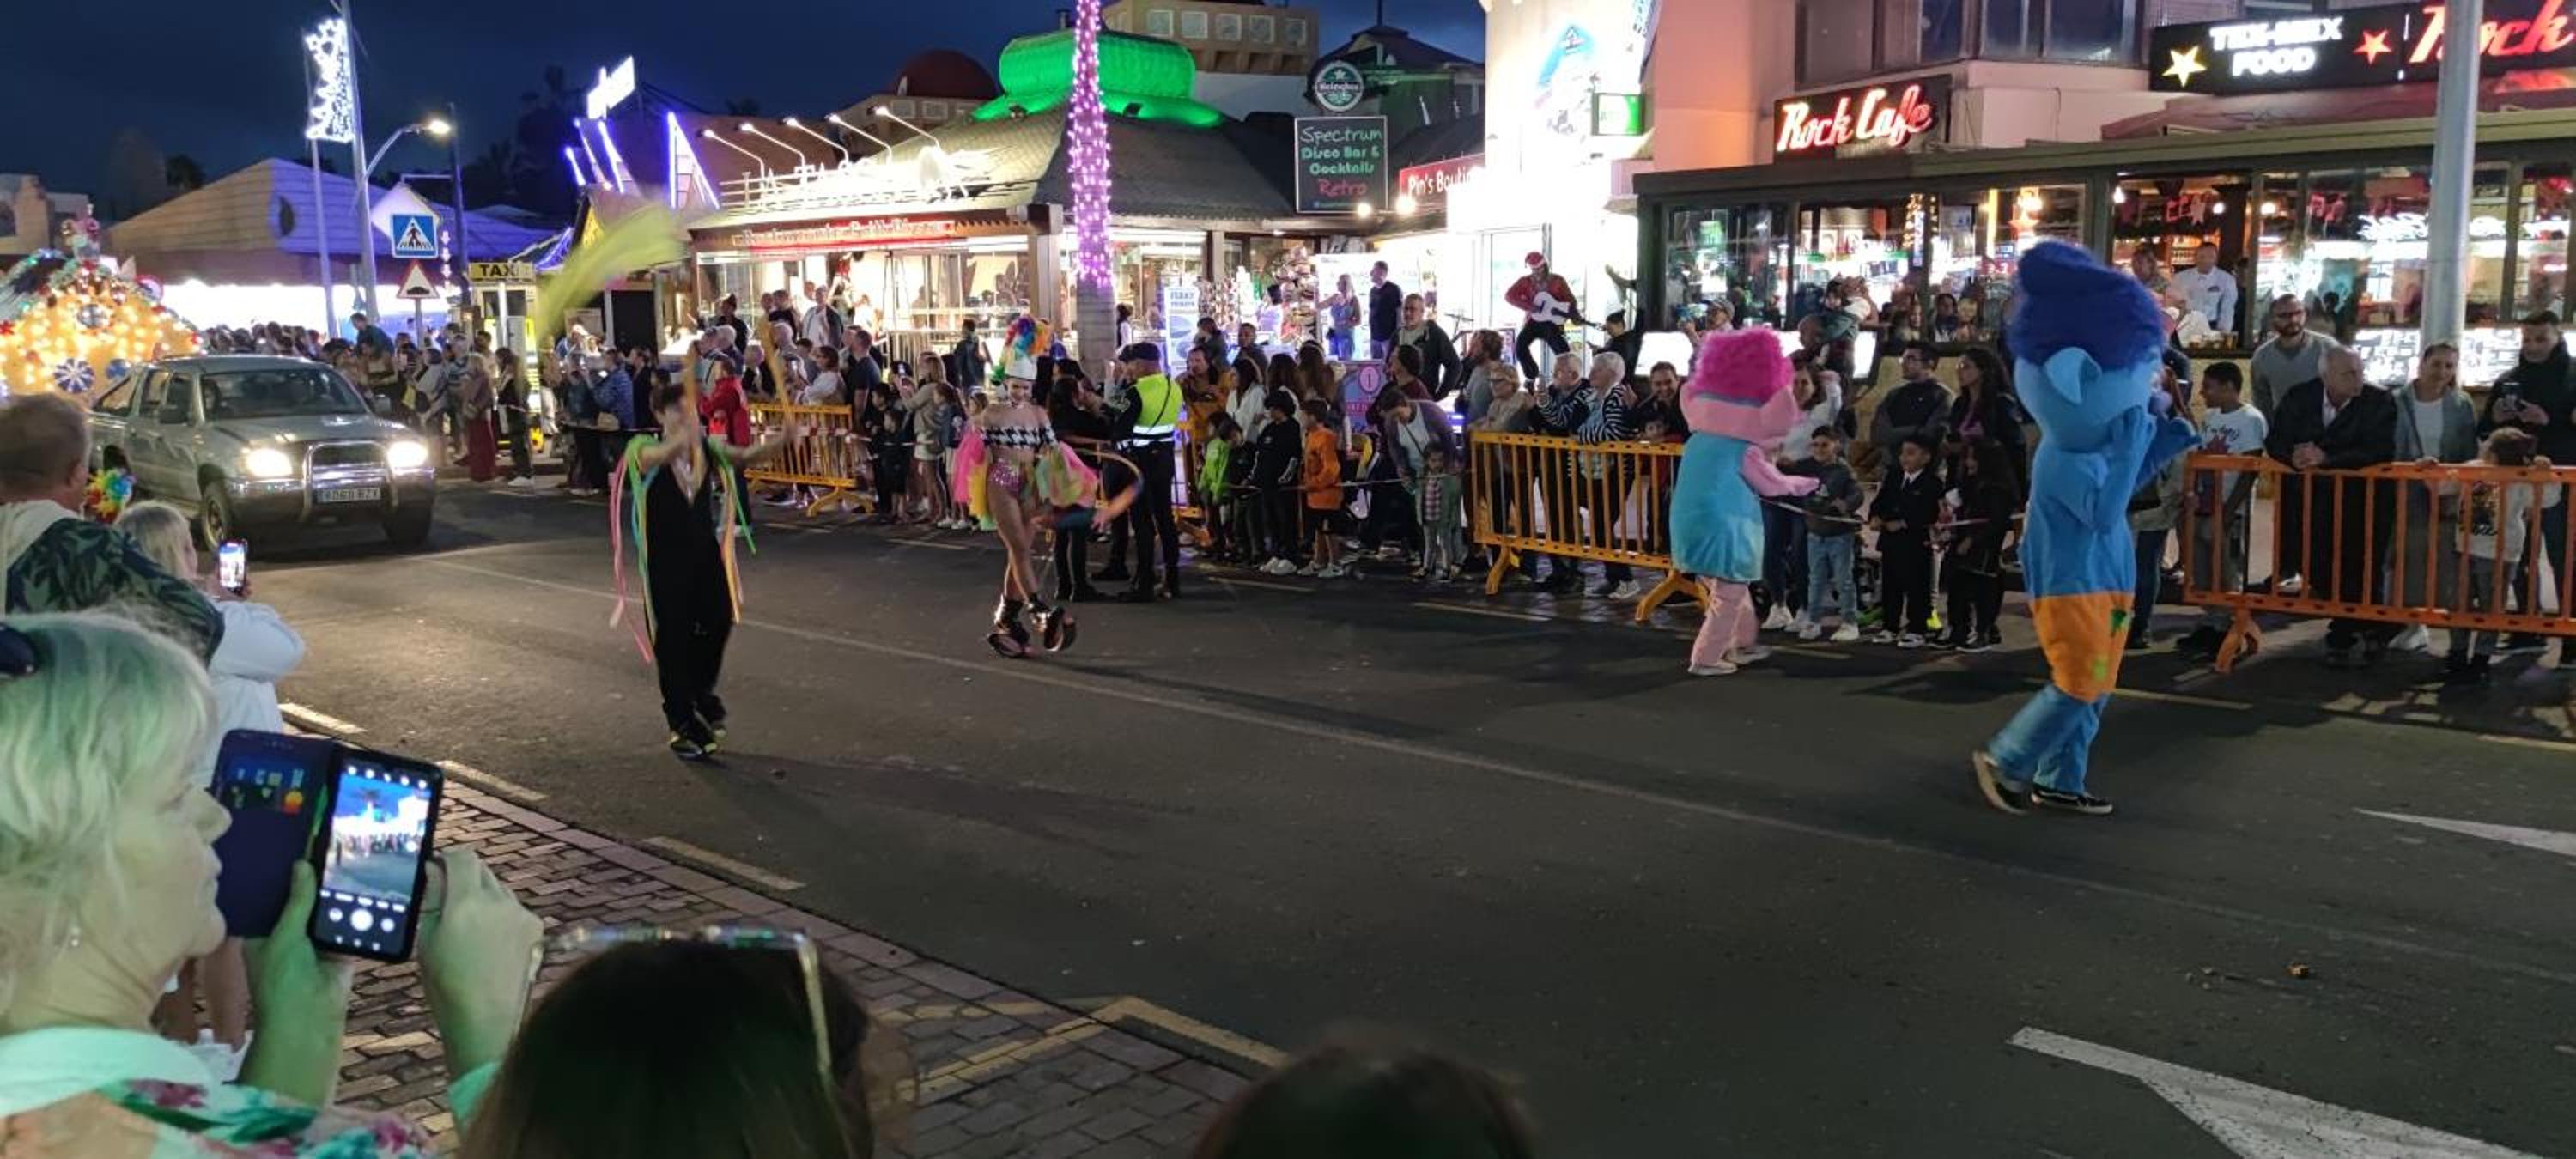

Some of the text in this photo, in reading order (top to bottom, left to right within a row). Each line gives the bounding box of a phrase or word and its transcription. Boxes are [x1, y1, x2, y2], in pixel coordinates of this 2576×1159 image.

[2208, 16, 2344, 51] TEX-MEX
[2232, 46, 2317, 76] FOOD
[1777, 95, 1854, 152] Rock
[1299, 126, 1383, 146] Spectrum
[1301, 147, 1340, 160] Disco
[1344, 145, 1367, 158] Bar
[1309, 161, 1376, 176] Cocktails
[1317, 177, 1369, 198] Retro
[1408, 173, 1434, 197] Pin's
[479, 264, 522, 277] TAXI
